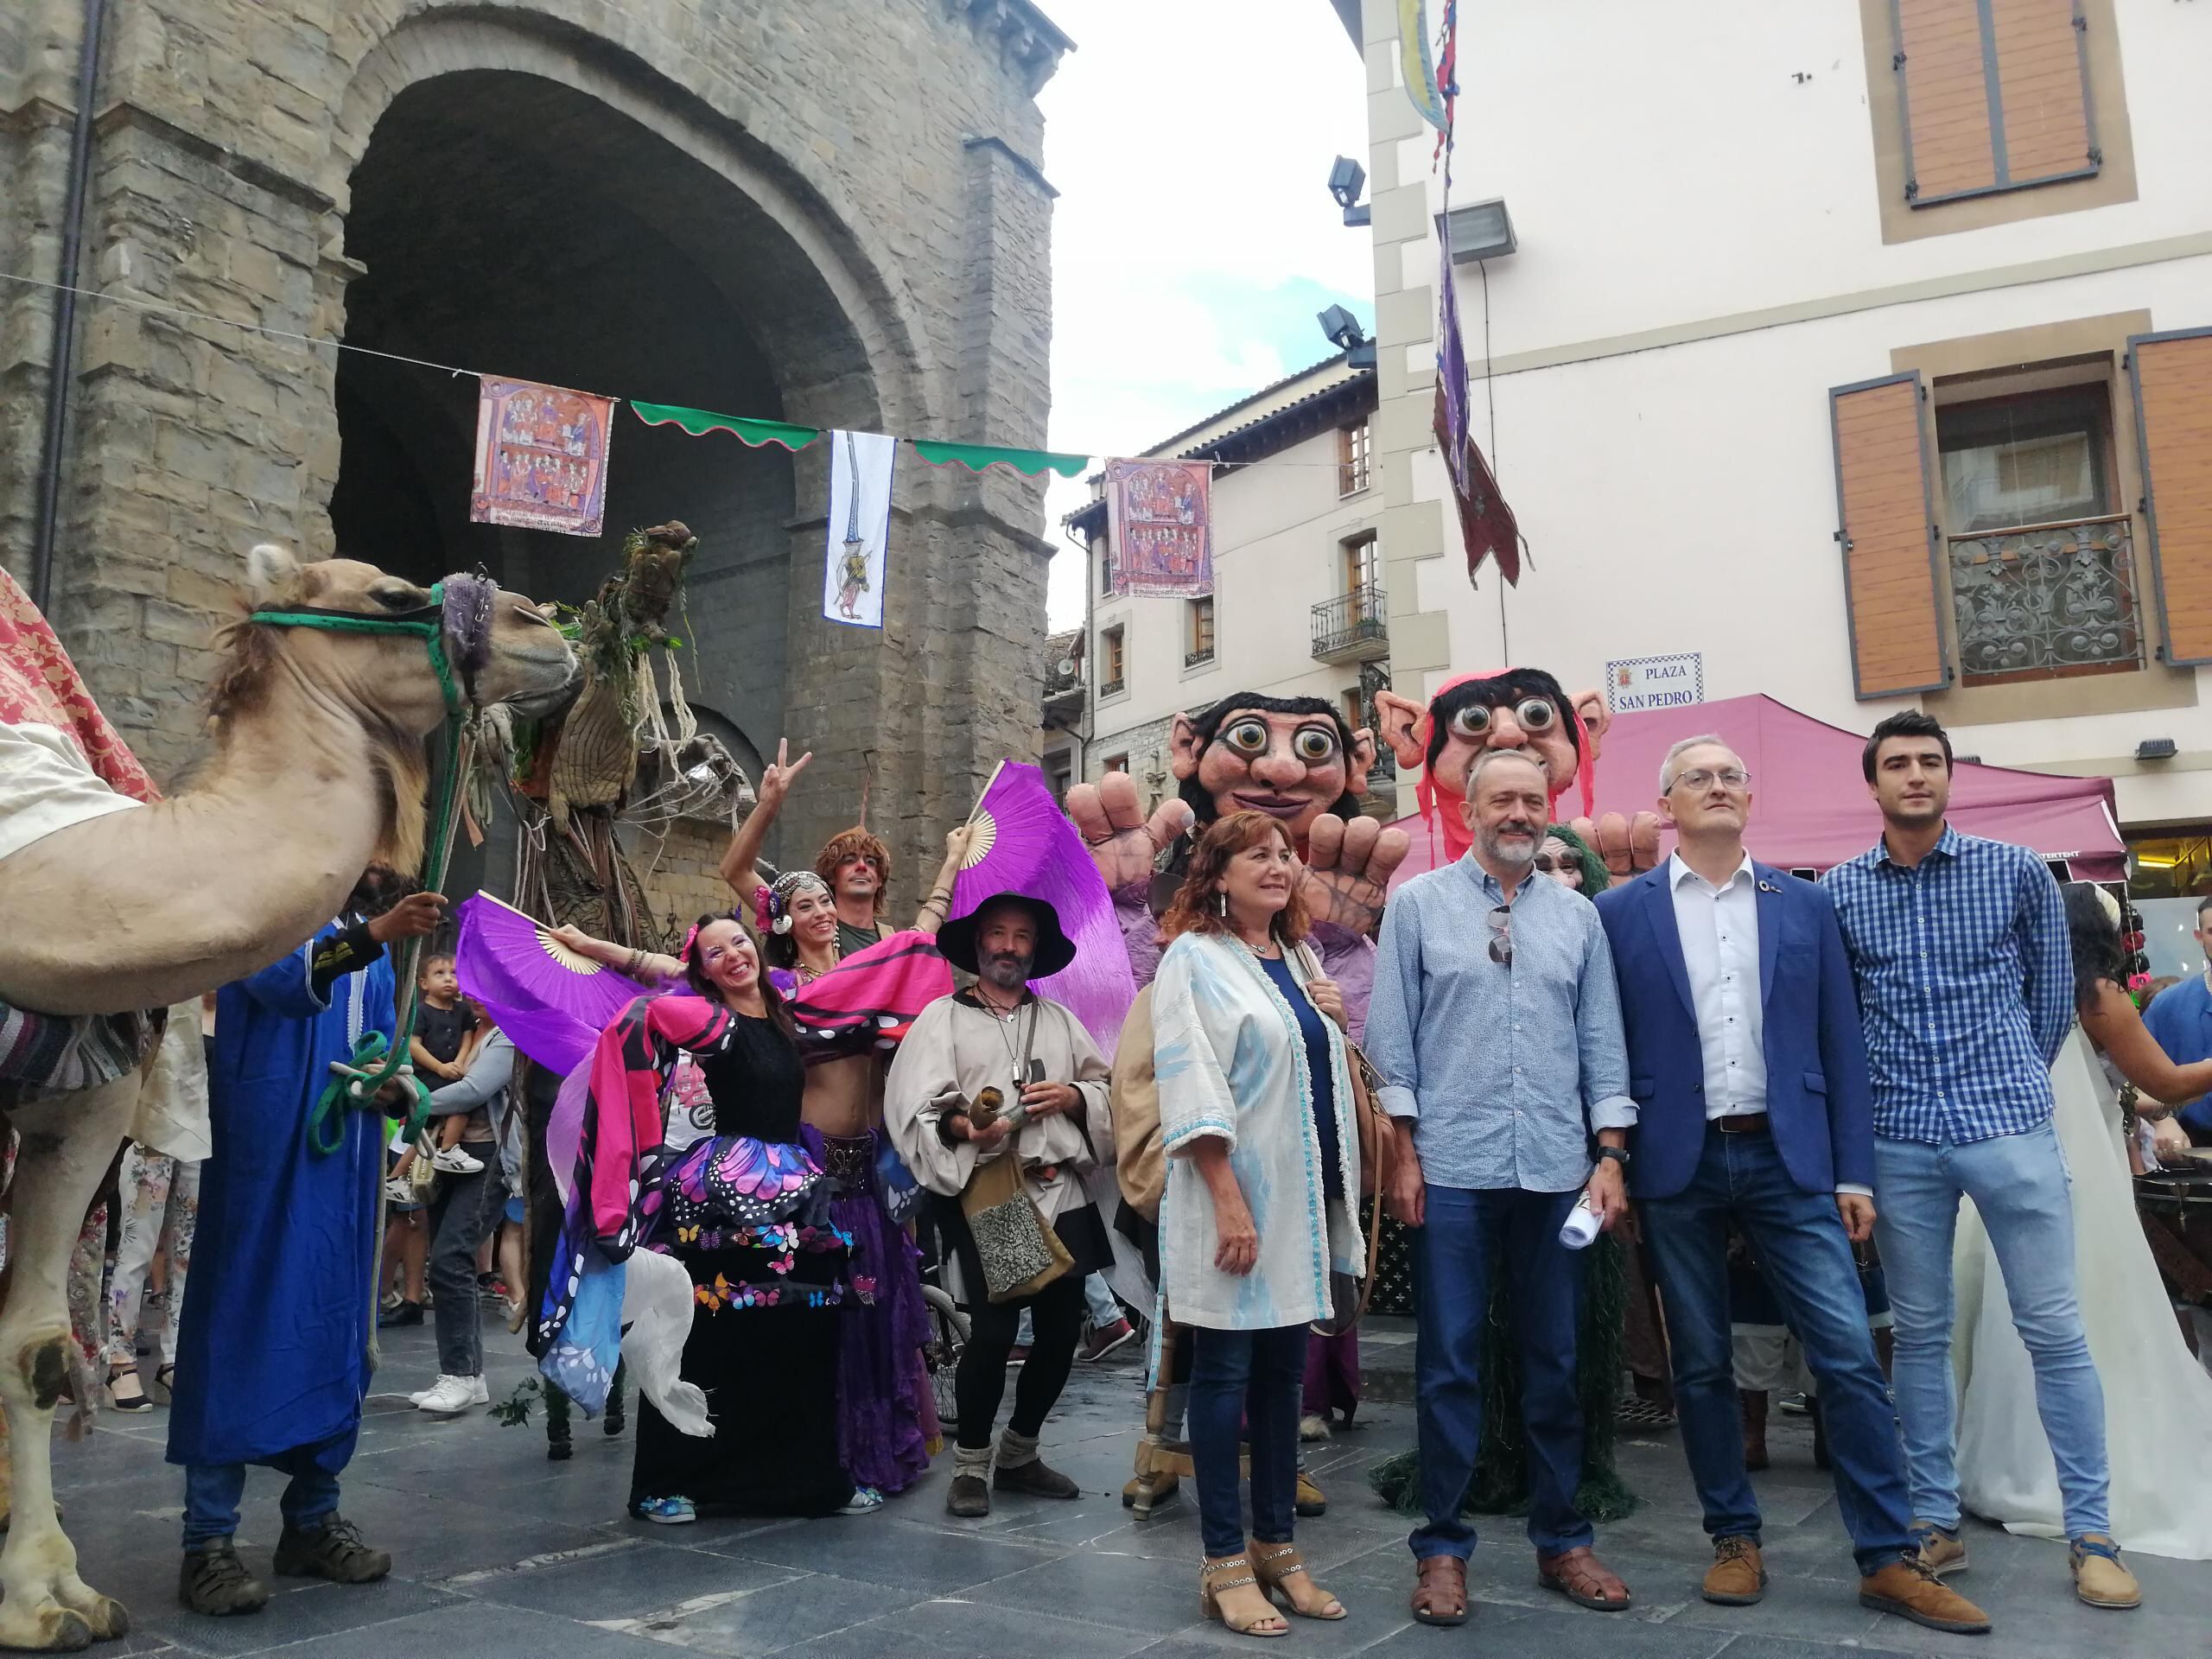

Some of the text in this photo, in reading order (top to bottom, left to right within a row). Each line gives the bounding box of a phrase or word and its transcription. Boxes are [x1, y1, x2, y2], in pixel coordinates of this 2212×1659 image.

[1645, 665, 1687, 679] PLAZA
[1619, 690, 1693, 709] SAN PEDRO
[2039, 850, 2081, 859] TERTENT
